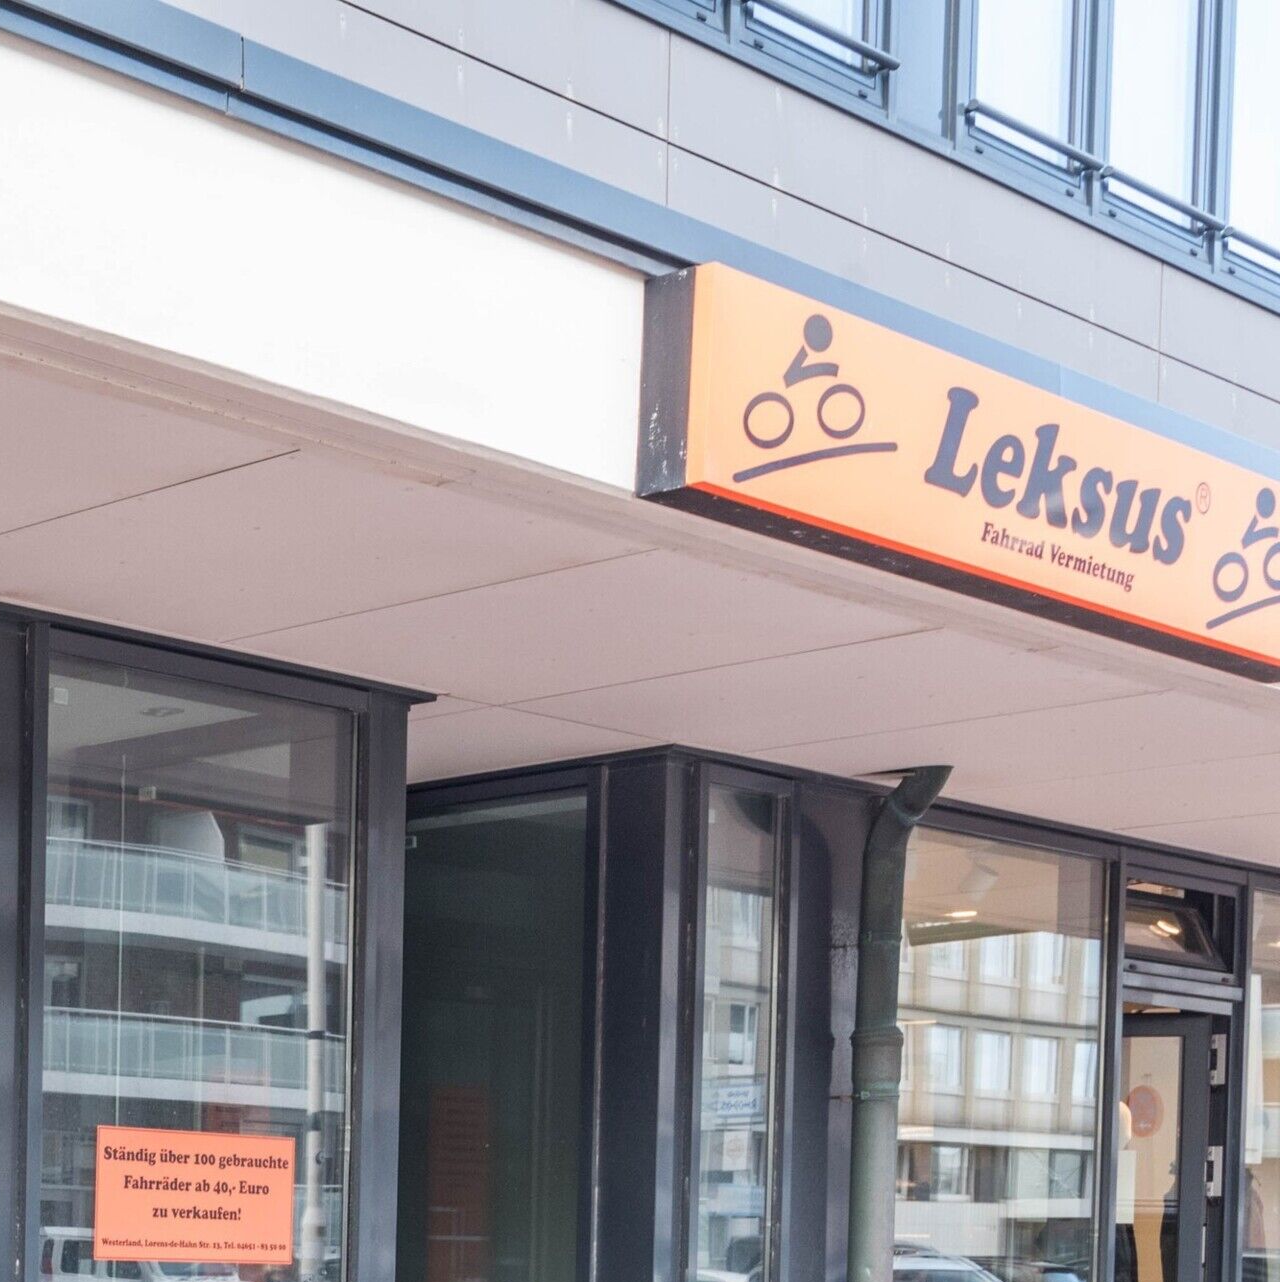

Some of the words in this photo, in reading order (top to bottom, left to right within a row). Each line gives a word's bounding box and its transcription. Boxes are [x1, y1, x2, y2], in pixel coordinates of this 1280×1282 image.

[924, 387, 1191, 565] Leksus
[981, 522, 1045, 560] Fahrrad
[1050, 543, 1135, 592] Vermietung
[104, 1146, 156, 1165] Ständig
[160, 1149, 190, 1164] über
[194, 1153, 216, 1165] 100
[218, 1154, 289, 1169] gebrauchte
[124, 1175, 192, 1192] Fahrräder
[195, 1178, 210, 1192] ab
[239, 1180, 269, 1195] Euro
[152, 1207, 168, 1218] zu
[172, 1206, 242, 1221] verkaufen!
[101, 1237, 143, 1248] Westerland,
